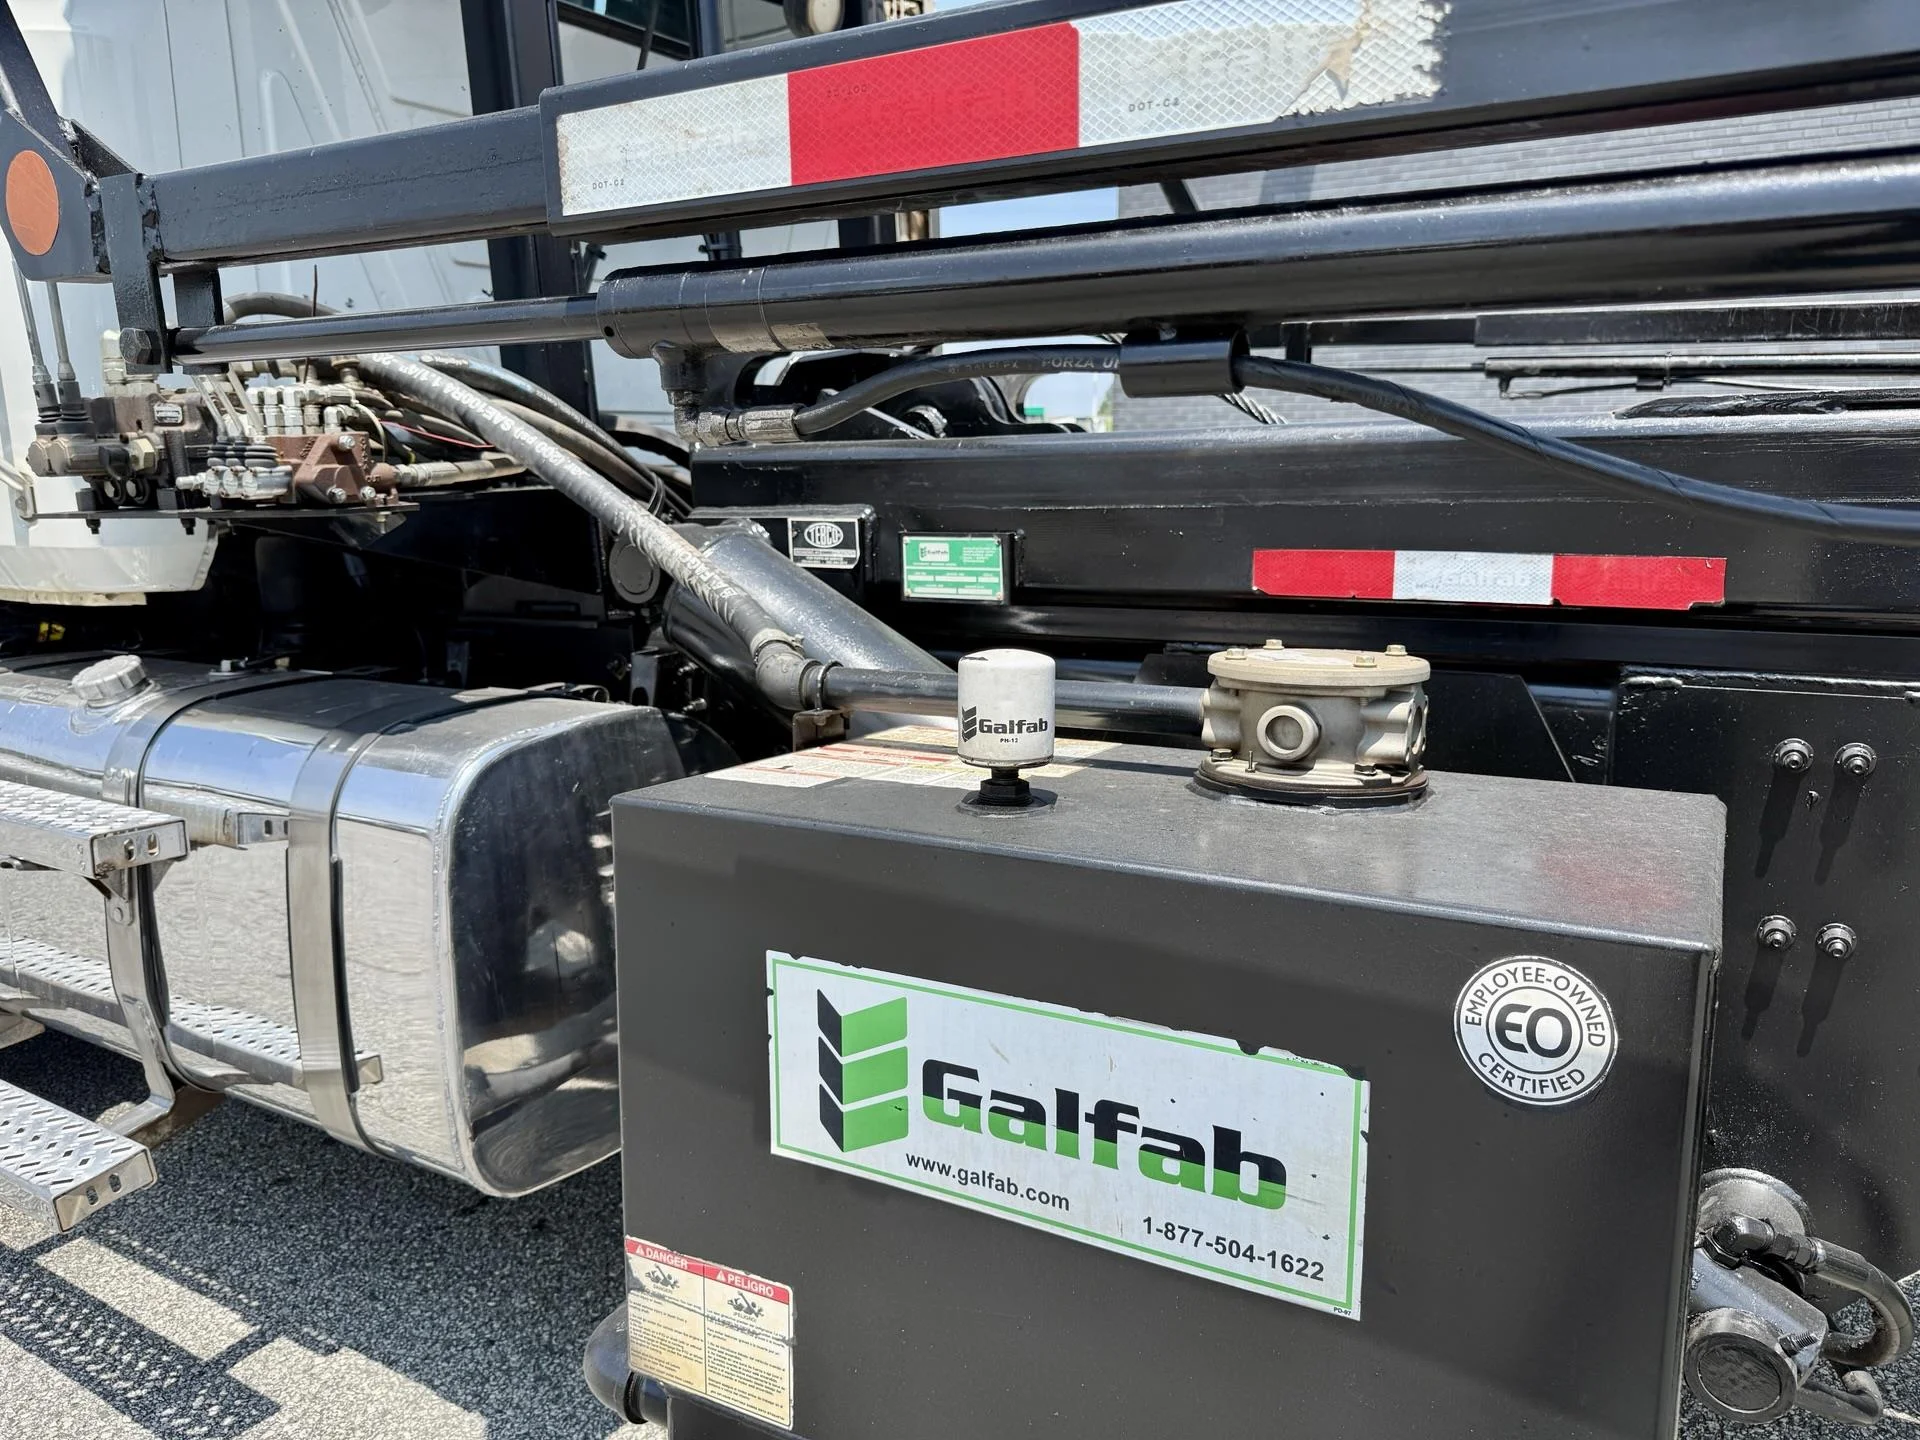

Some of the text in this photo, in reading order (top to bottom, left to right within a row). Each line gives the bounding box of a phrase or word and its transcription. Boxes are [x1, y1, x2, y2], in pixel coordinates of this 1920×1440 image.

[1128, 97, 1181, 113] DOT-C2
[592, 179, 626, 190] DOT-C2
[442, 382, 515, 431] SAE100R4
[979, 718, 1048, 734] Galfab
[1465, 966, 1606, 1047] EMPLOYEE-OWNED
[1495, 1003, 1573, 1058] EO
[1478, 1052, 1585, 1094] CERTIFIED
[922, 1059, 1287, 1211] Galfab
[905, 1152, 1070, 1212] www.galfab.com
[645, 1248, 688, 1269] DANGER
[1142, 1216, 1325, 1282] 1-877-504-1622
[727, 1274, 774, 1297] PELIGRO
